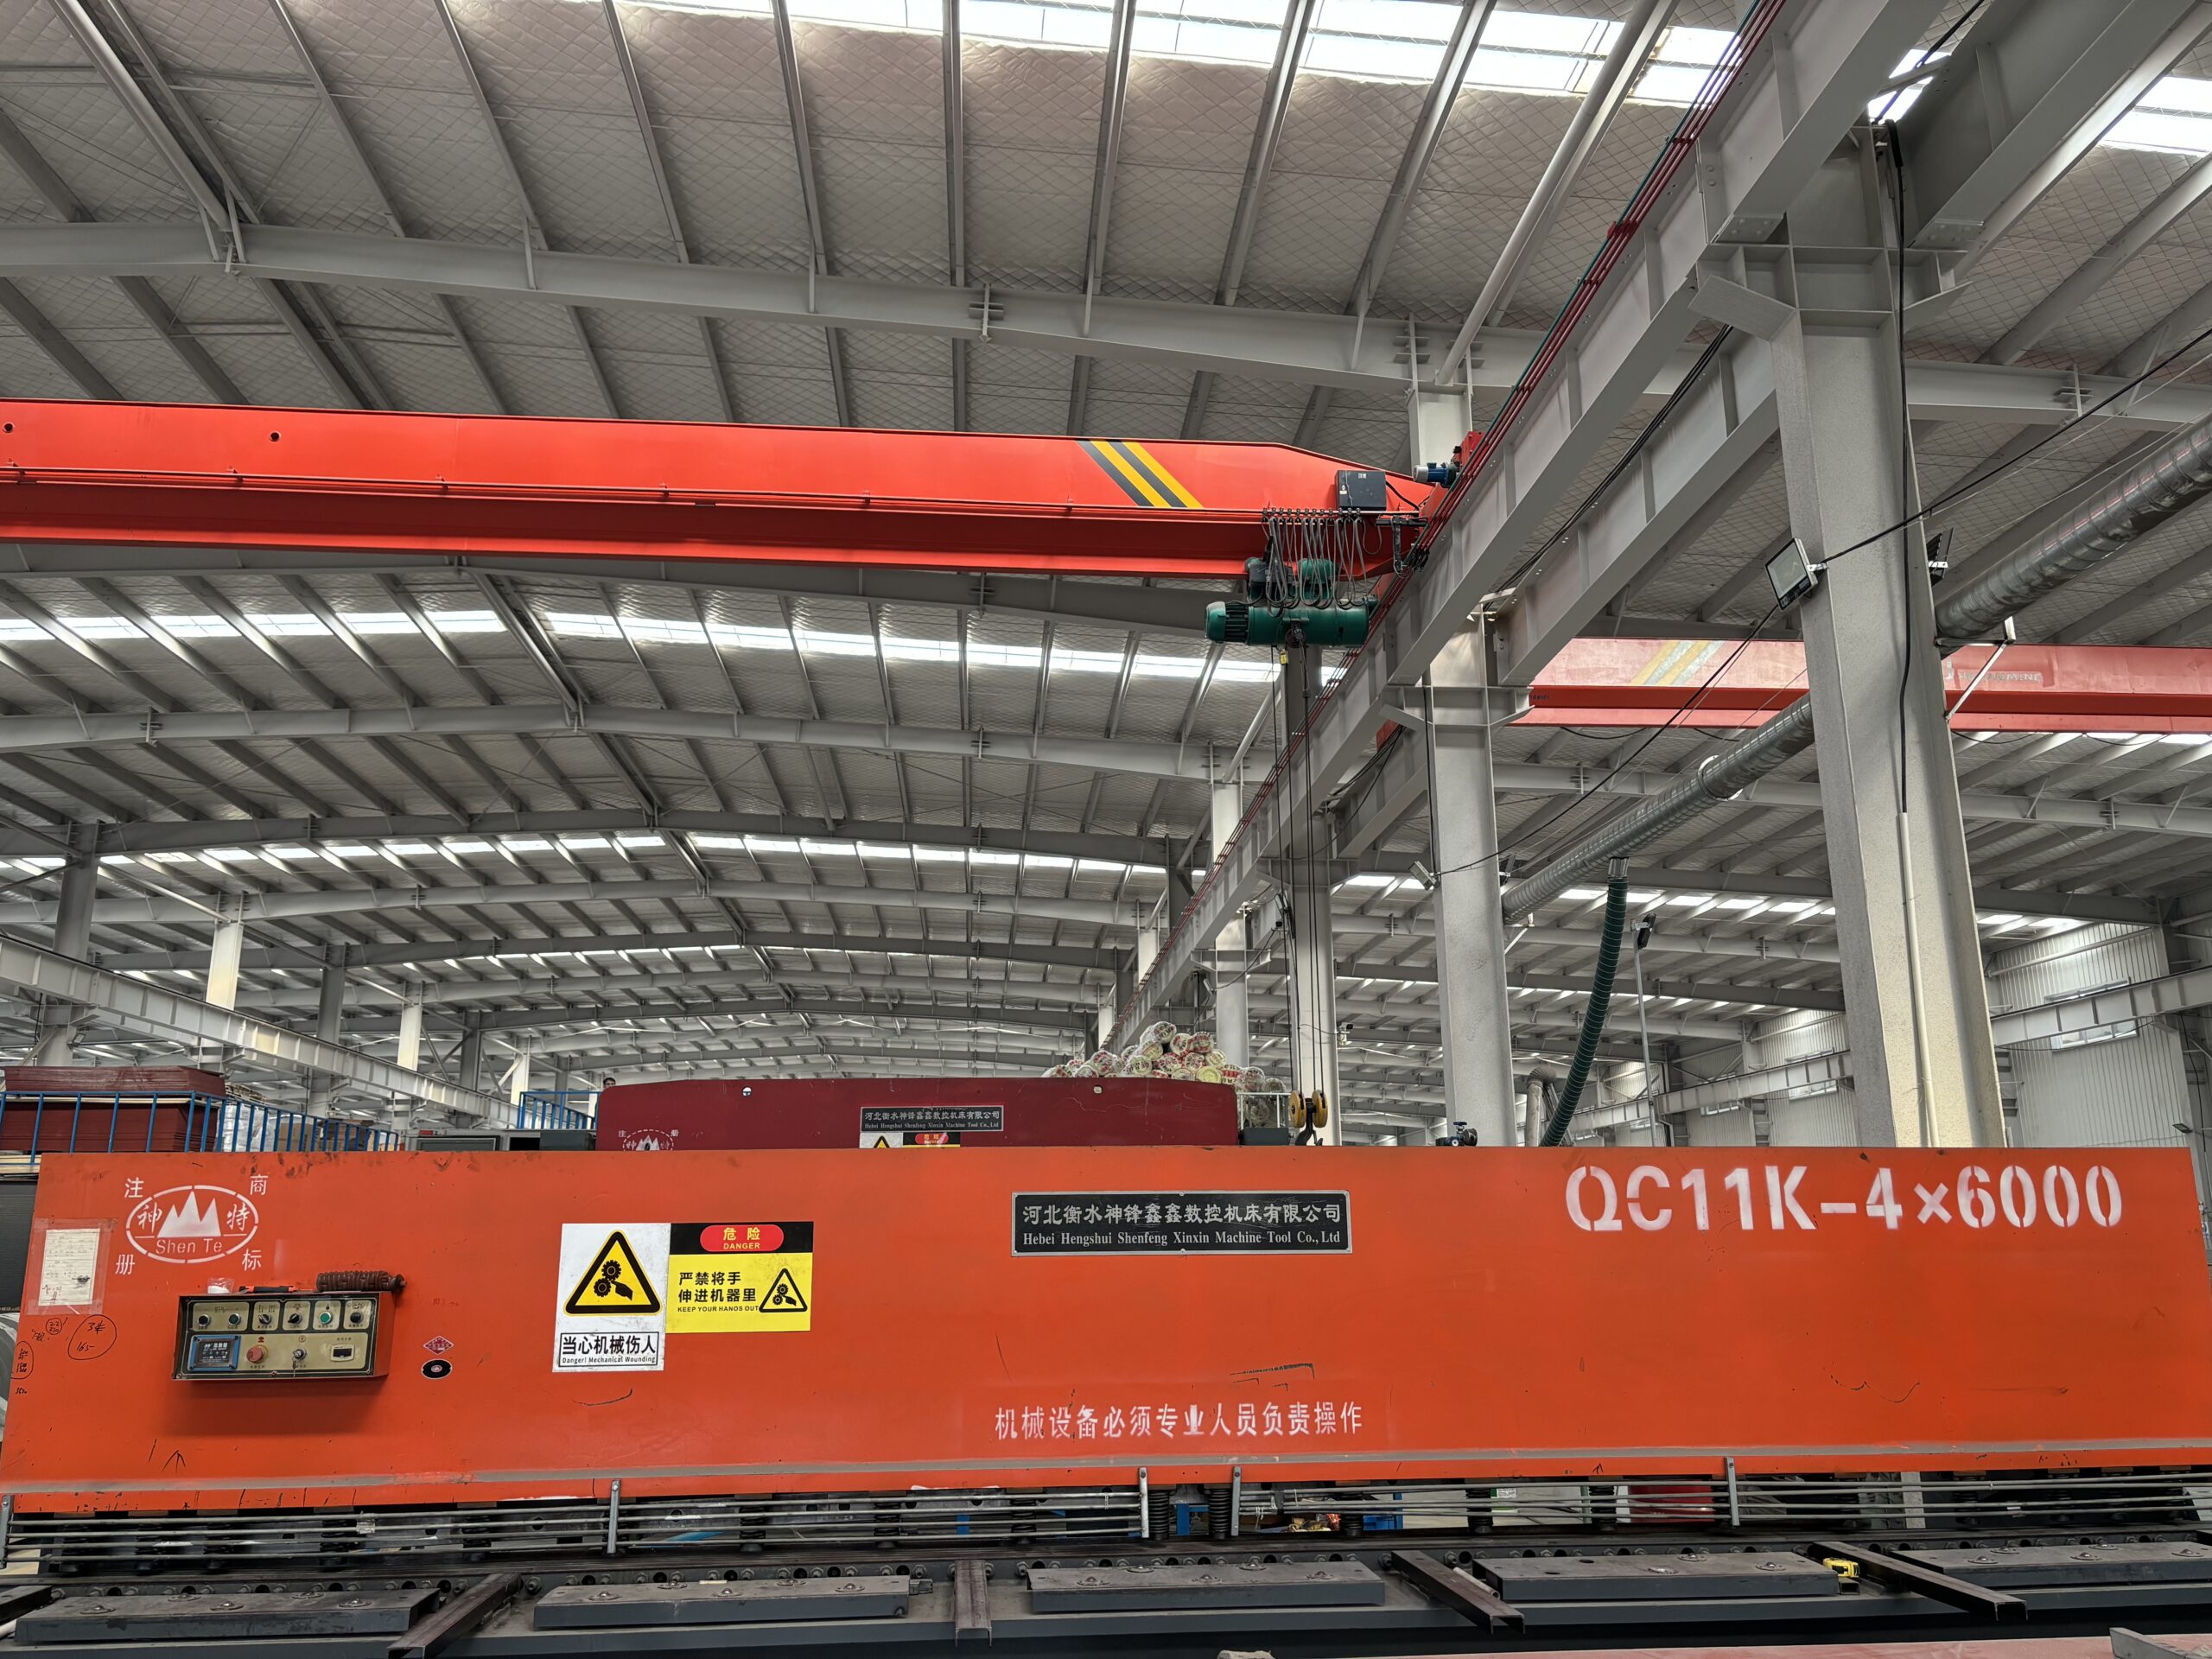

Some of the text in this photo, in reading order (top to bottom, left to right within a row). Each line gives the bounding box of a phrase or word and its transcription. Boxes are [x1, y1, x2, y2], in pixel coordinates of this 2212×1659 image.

[124, 1177, 144, 1198] 注
[250, 1174, 269, 1196] 商
[1022, 1203, 1341, 1225] 河北衡水神锋鑫鑫数控机床有限公司
[156, 1237, 223, 1253] Shen Te
[1023, 1232, 1055, 1245] Hebei
[1061, 1232, 1112, 1247] Hengshui
[1117, 1231, 1167, 1247] Shenfeng
[1173, 1231, 1210, 1243] Xinxin
[1215, 1231, 1262, 1243] Machine
[1267, 1231, 1291, 1243] Tool
[115, 1254, 136, 1274] 册
[242, 1249, 262, 1271] 标
[679, 1272, 741, 1286] 严禁将手
[678, 1288, 756, 1303] 伸进机器里
[562, 1335, 656, 1355] 当心机械伤人
[995, 1402, 1363, 1440] 机械设备必须专业人员负责操作
